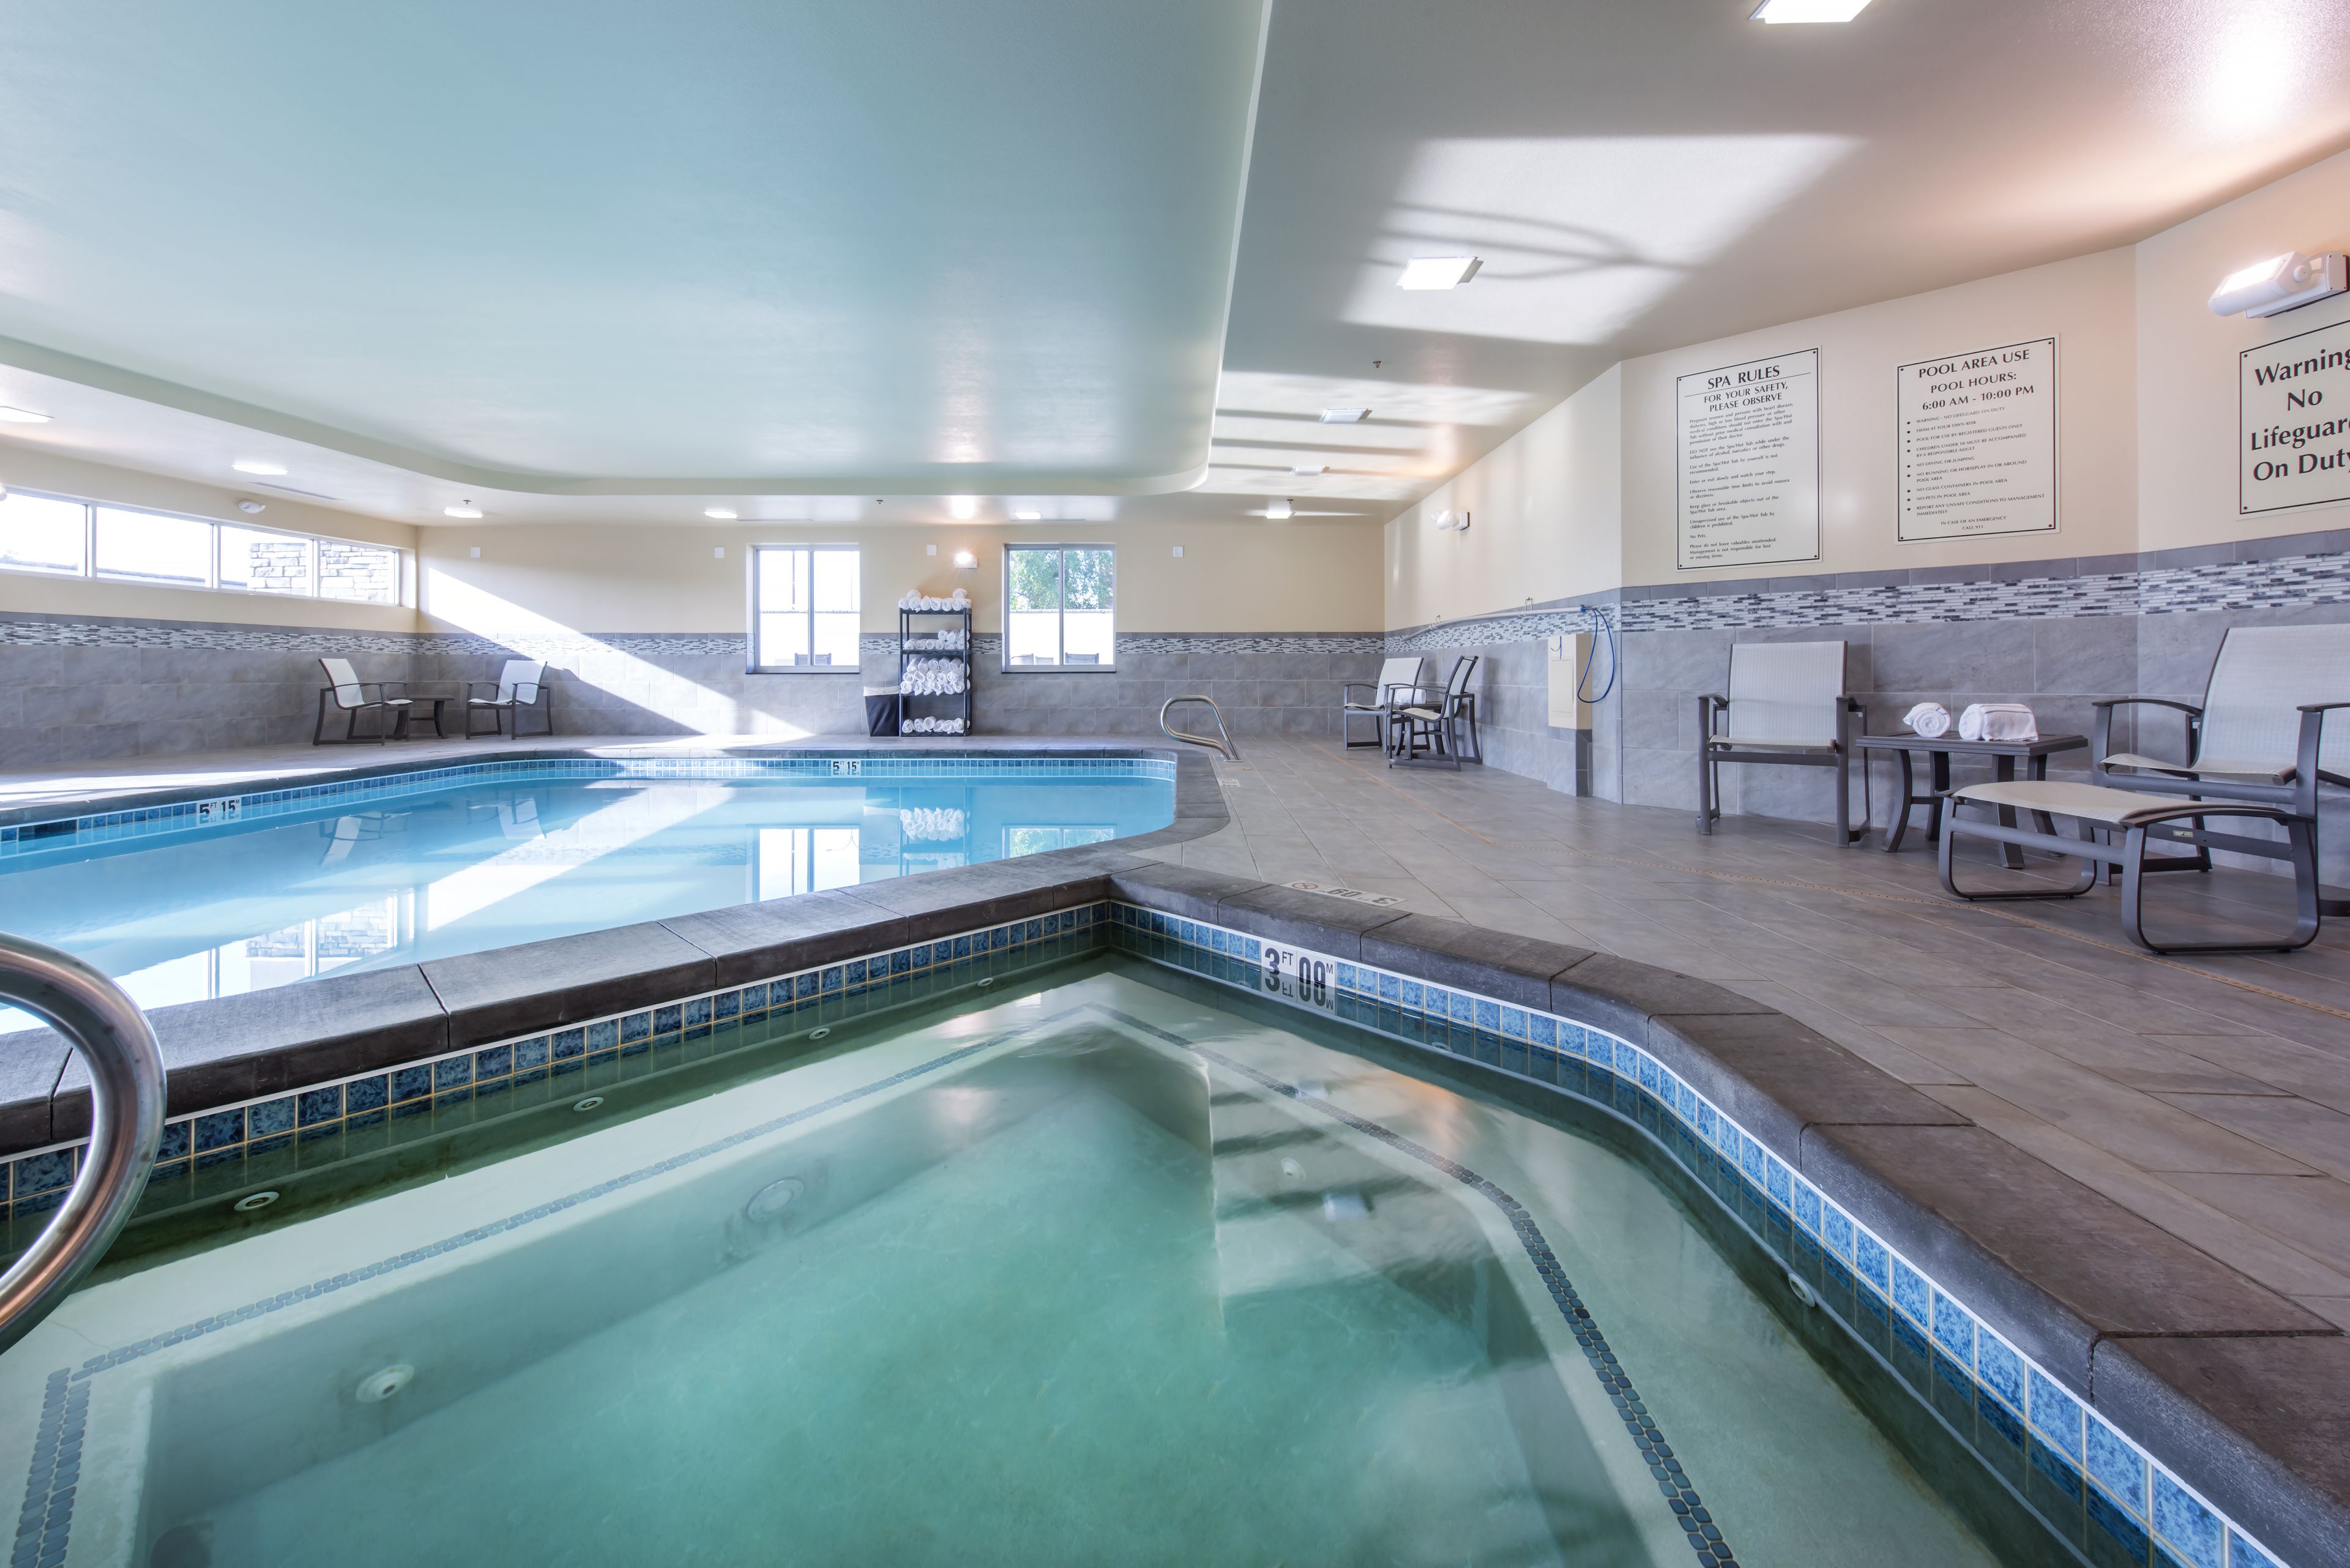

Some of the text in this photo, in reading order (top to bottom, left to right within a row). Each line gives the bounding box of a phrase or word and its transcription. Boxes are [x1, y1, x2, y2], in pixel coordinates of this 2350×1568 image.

[1919, 349, 2030, 378] POOL AREA USE
[1707, 365, 1780, 390] SPA RULES
[1931, 371, 2016, 394] POOL HOURS:
[1704, 381, 1788, 403] FOR YOUR SAFETY,
[1709, 392, 1782, 412] PLEASE OBSERVE
[1922, 399, 1945, 410] 6:00
[1949, 395, 1968, 406] AM
[1980, 389, 2011, 401] 10:00
[2015, 385, 2034, 396] PM
[2287, 389, 2323, 411] No
[1952, 410, 1980, 418] LIFEGUARD
[1958, 428, 1987, 436] REGISTERED
[1988, 433, 2026, 442] ACCOMPANIED
[2251, 417, 2350, 451] Lifeguar
[1689, 466, 1719, 475] recommended.
[2253, 461, 2289, 481] On
[833, 761, 840, 769] 5
[200, 803, 210, 814] 5
[1265, 948, 1280, 974] 3
[1282, 951, 1293, 965] FT
[1326, 963, 1333, 974] M
